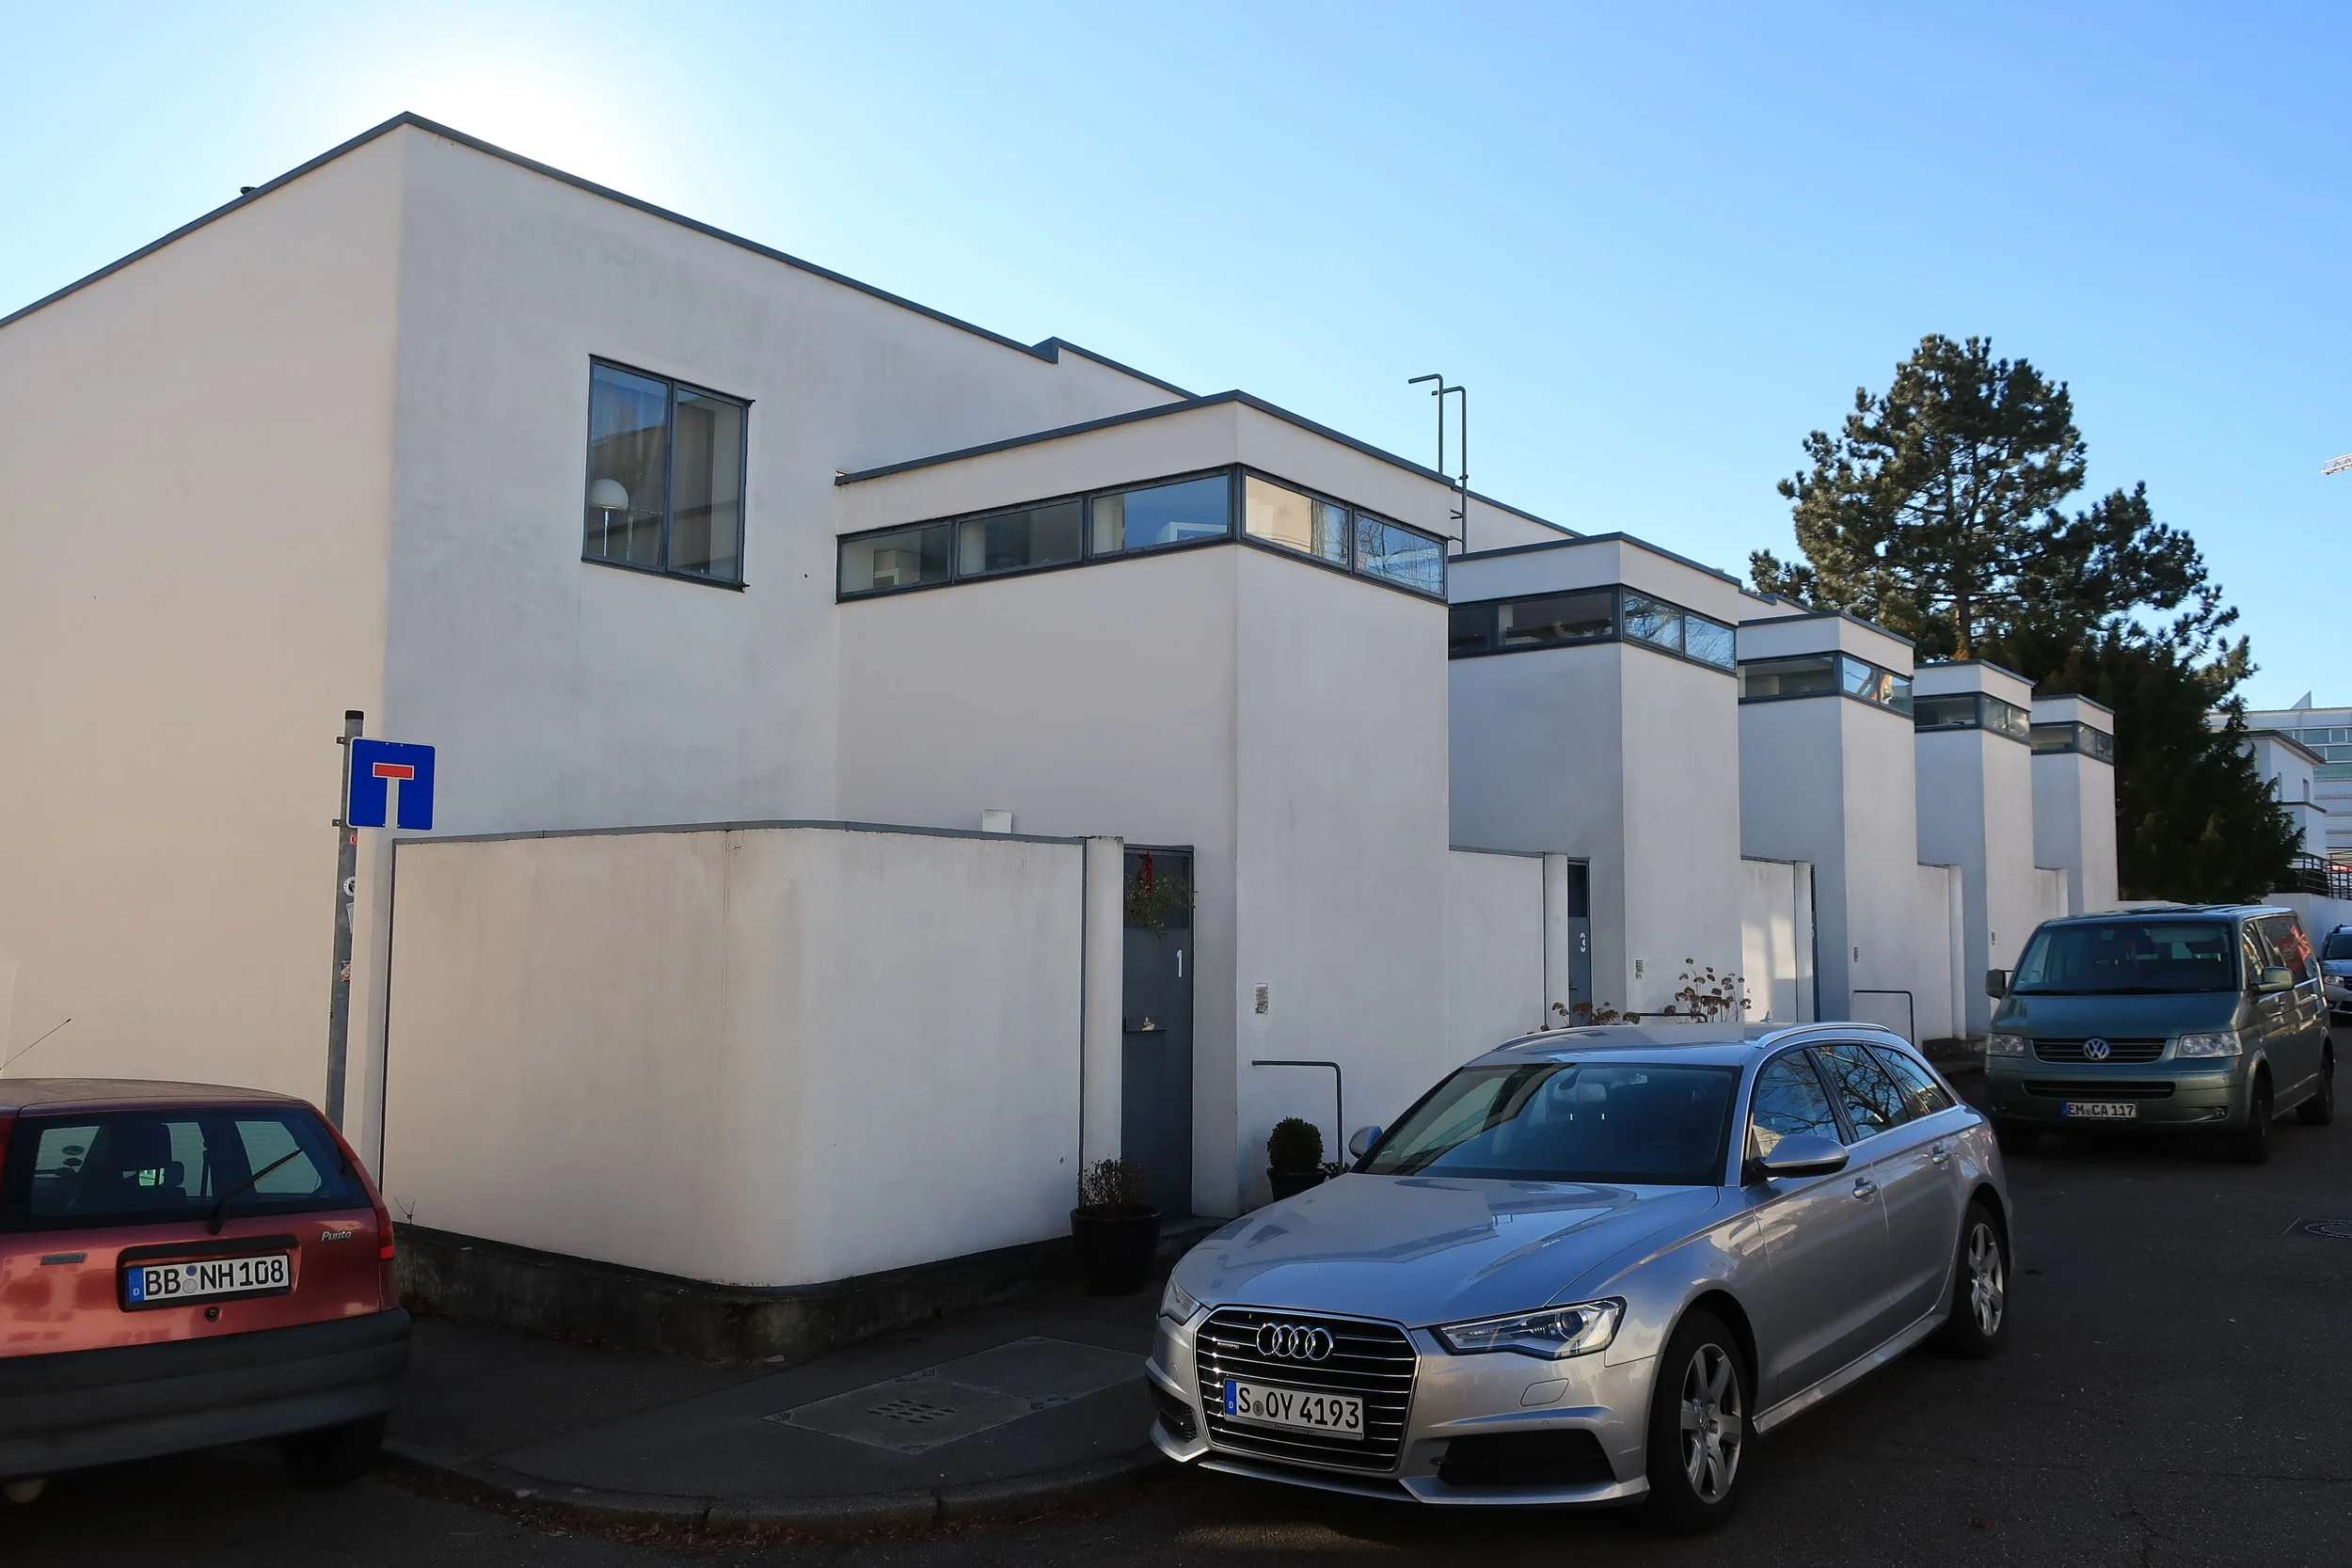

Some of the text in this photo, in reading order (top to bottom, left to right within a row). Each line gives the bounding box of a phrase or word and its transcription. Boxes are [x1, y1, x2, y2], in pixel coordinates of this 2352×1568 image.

[1580, 932, 1586, 953] 3
[1176, 949, 1183, 978] 1
[2068, 1104, 2135, 1117] EM CA 117
[321, 1230, 352, 1242] Punto
[145, 1259, 283, 1296] BB NH 108
[1238, 1386, 1359, 1429] S OY 4193
